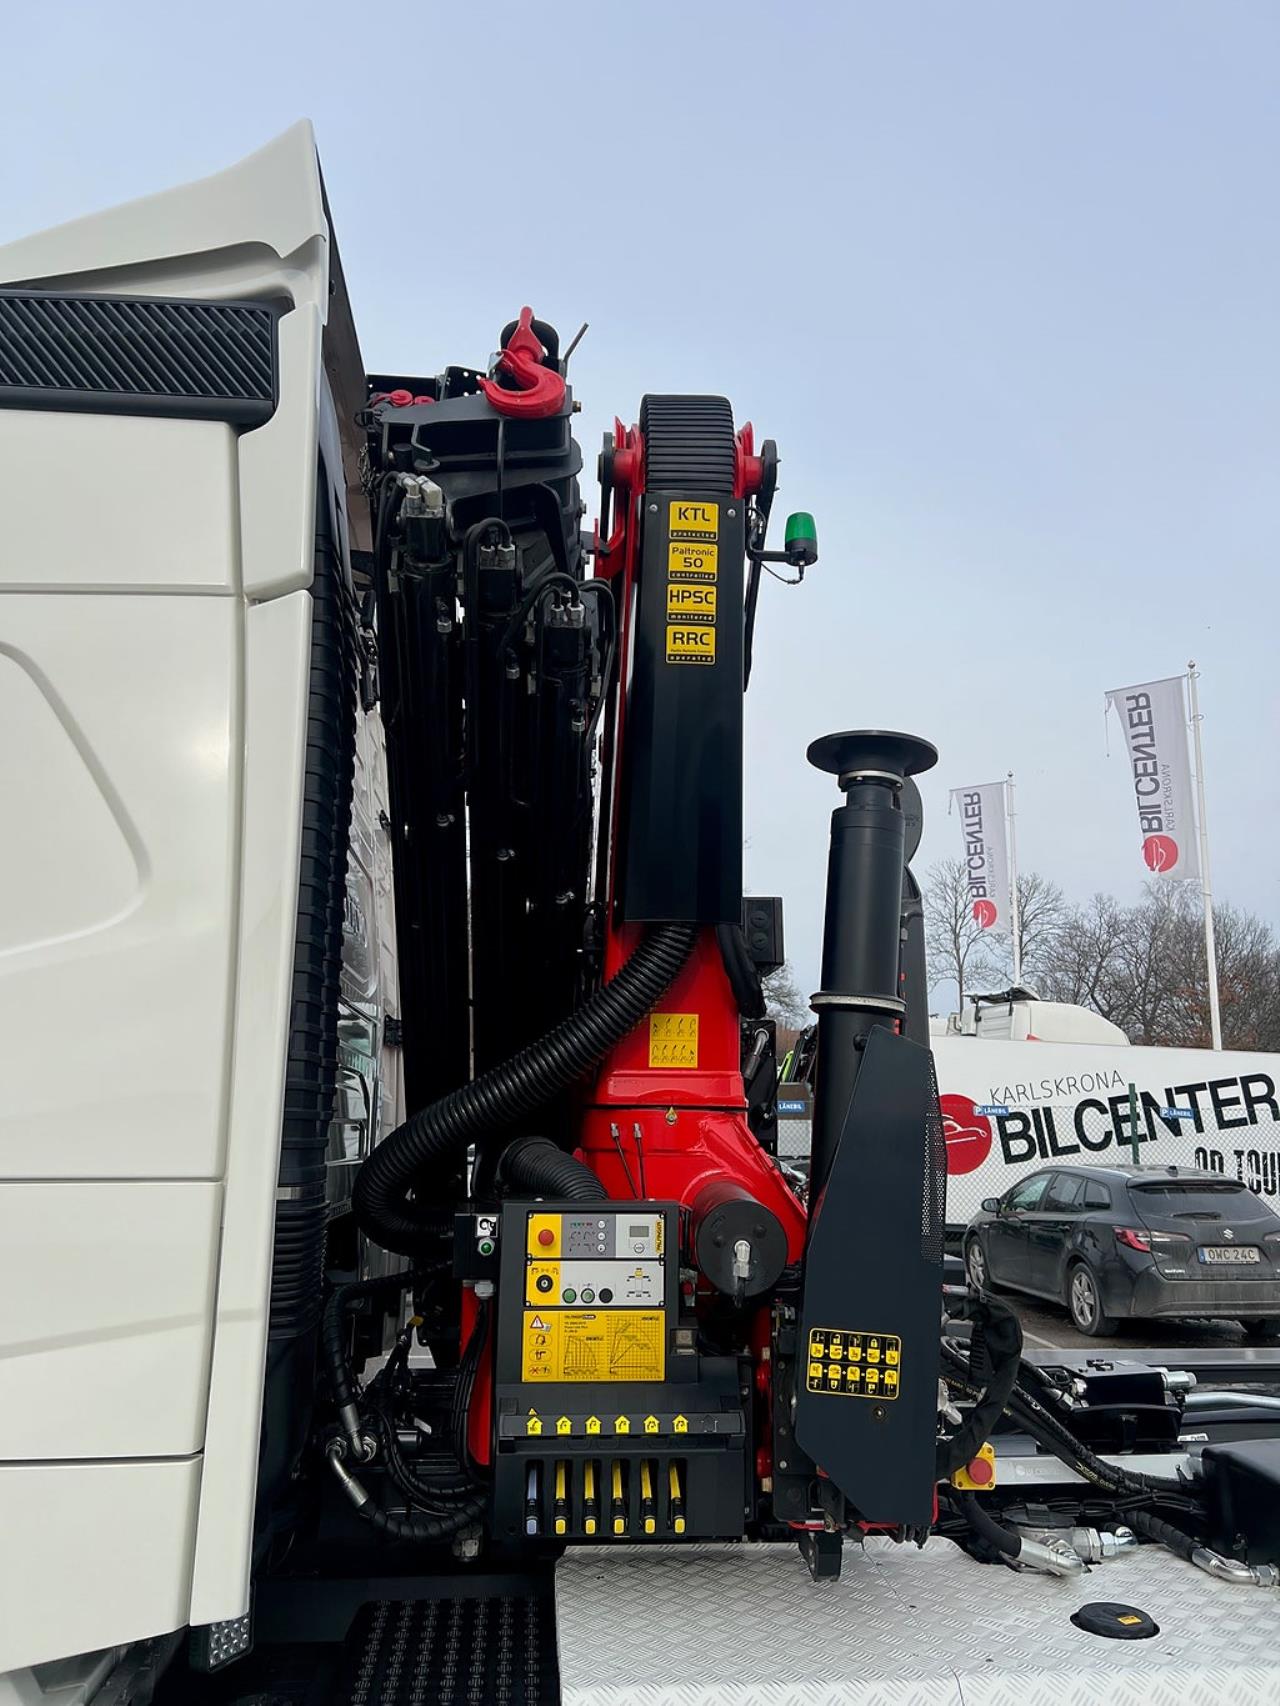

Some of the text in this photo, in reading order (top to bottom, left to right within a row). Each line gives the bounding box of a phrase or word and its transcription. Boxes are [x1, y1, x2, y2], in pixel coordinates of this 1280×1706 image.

[678, 507, 711, 522] KTL
[672, 547, 715, 557] Paltronic
[683, 557, 703, 568] 50
[669, 590, 714, 605] HPSC
[672, 632, 710, 646] RRC
[990, 1070, 1125, 1105] KARLSKRONA
[996, 1073, 1280, 1164] BILCENTER
